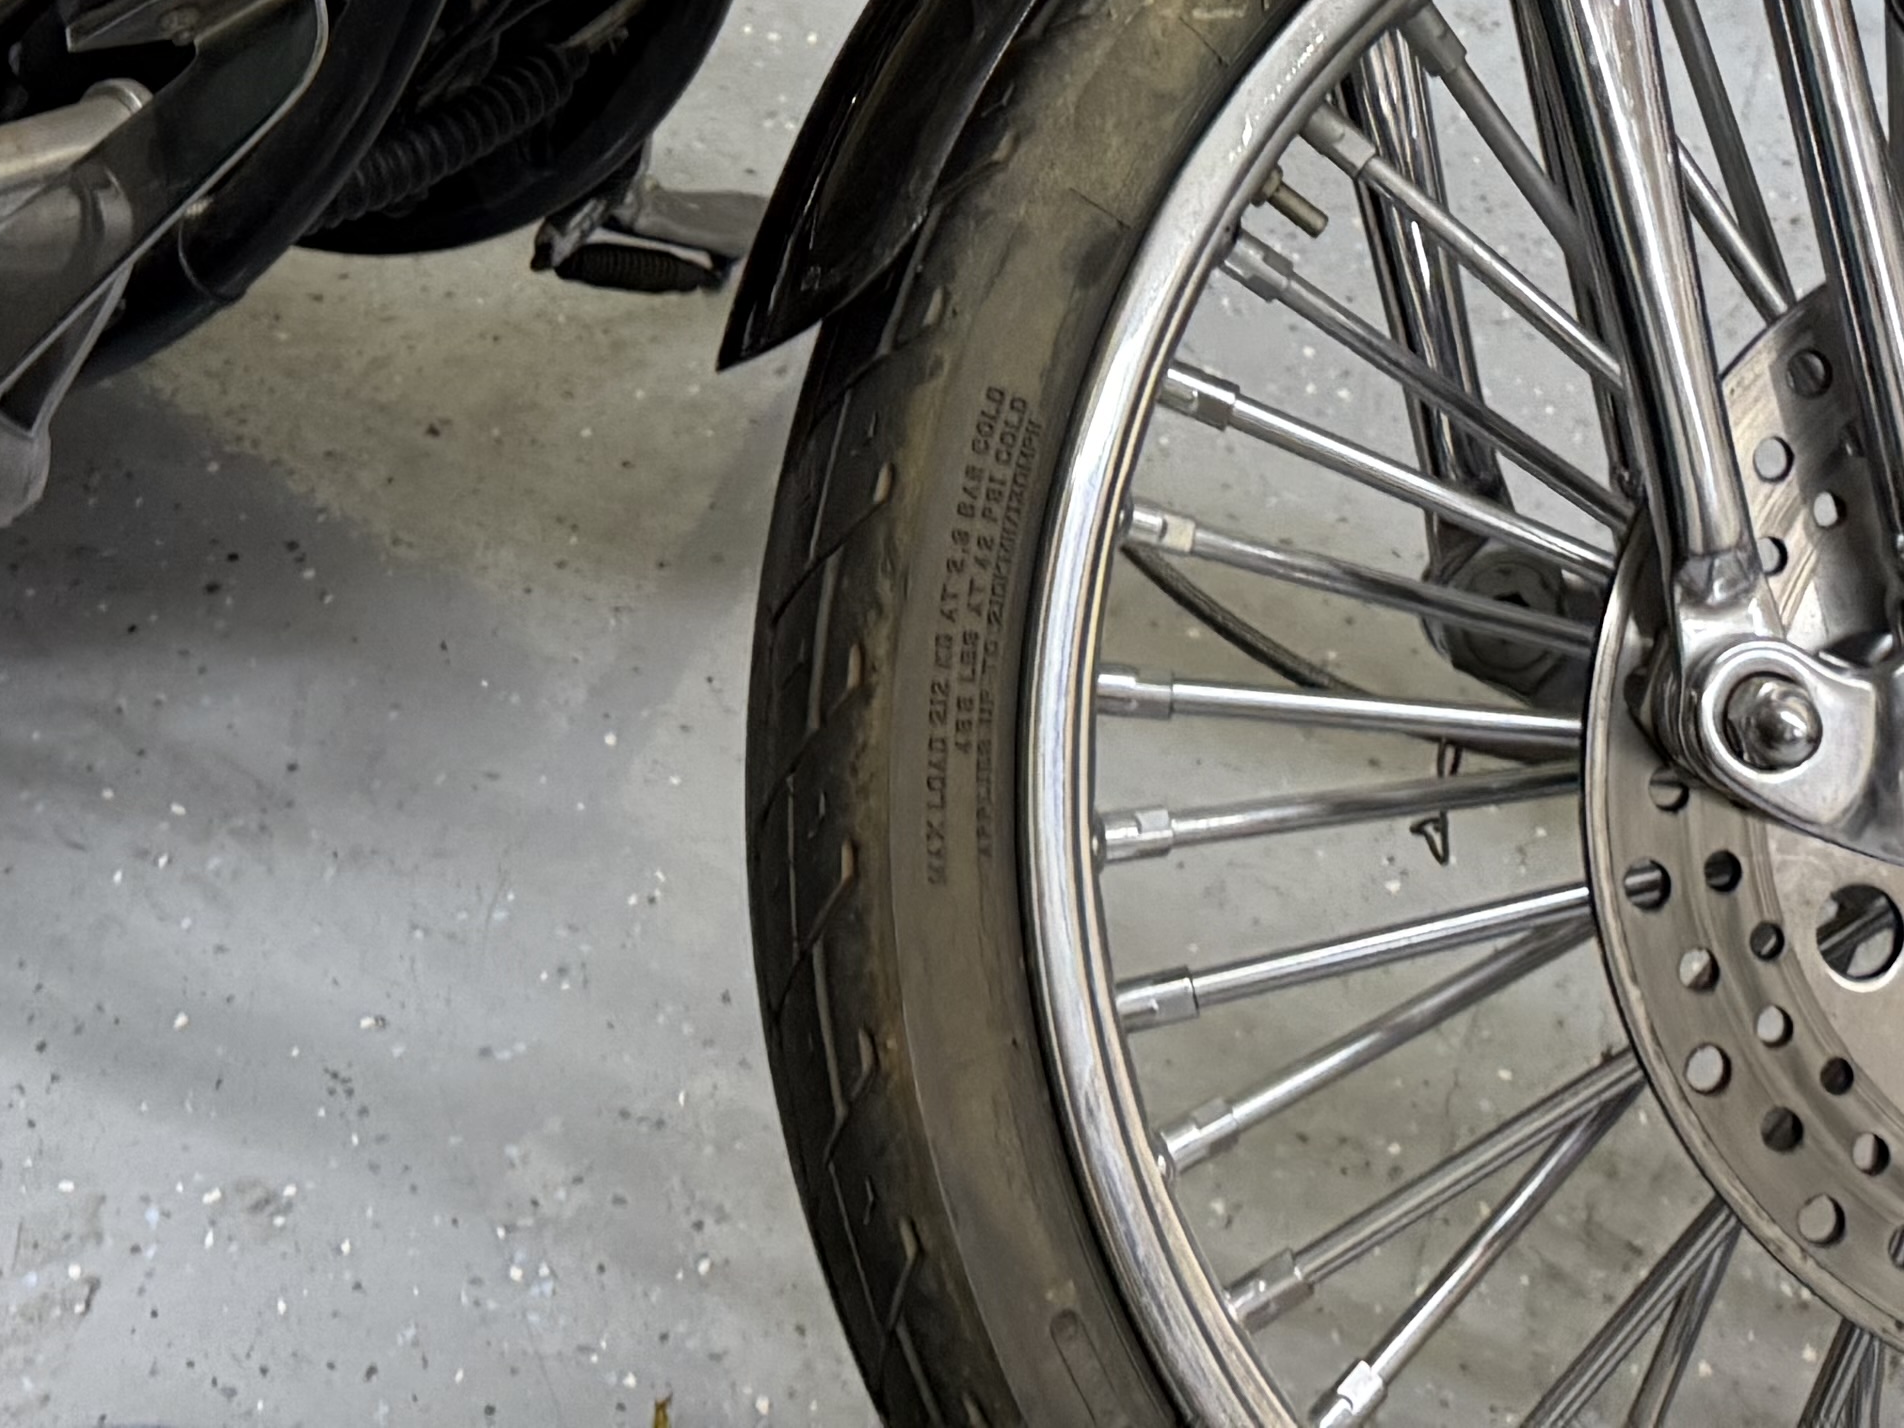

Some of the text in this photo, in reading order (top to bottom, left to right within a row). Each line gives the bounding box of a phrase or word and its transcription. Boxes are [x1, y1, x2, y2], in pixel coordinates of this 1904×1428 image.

[970, 386, 1006, 457] COLD
[995, 394, 1029, 467] COLD
[957, 464, 984, 519] BAR
[981, 472, 1009, 523] PSI
[973, 533, 995, 569] 42
[939, 584, 959, 622] AT
[965, 577, 987, 616] AT
[928, 680, 950, 725] 212
[926, 738, 948, 809] LOAD
